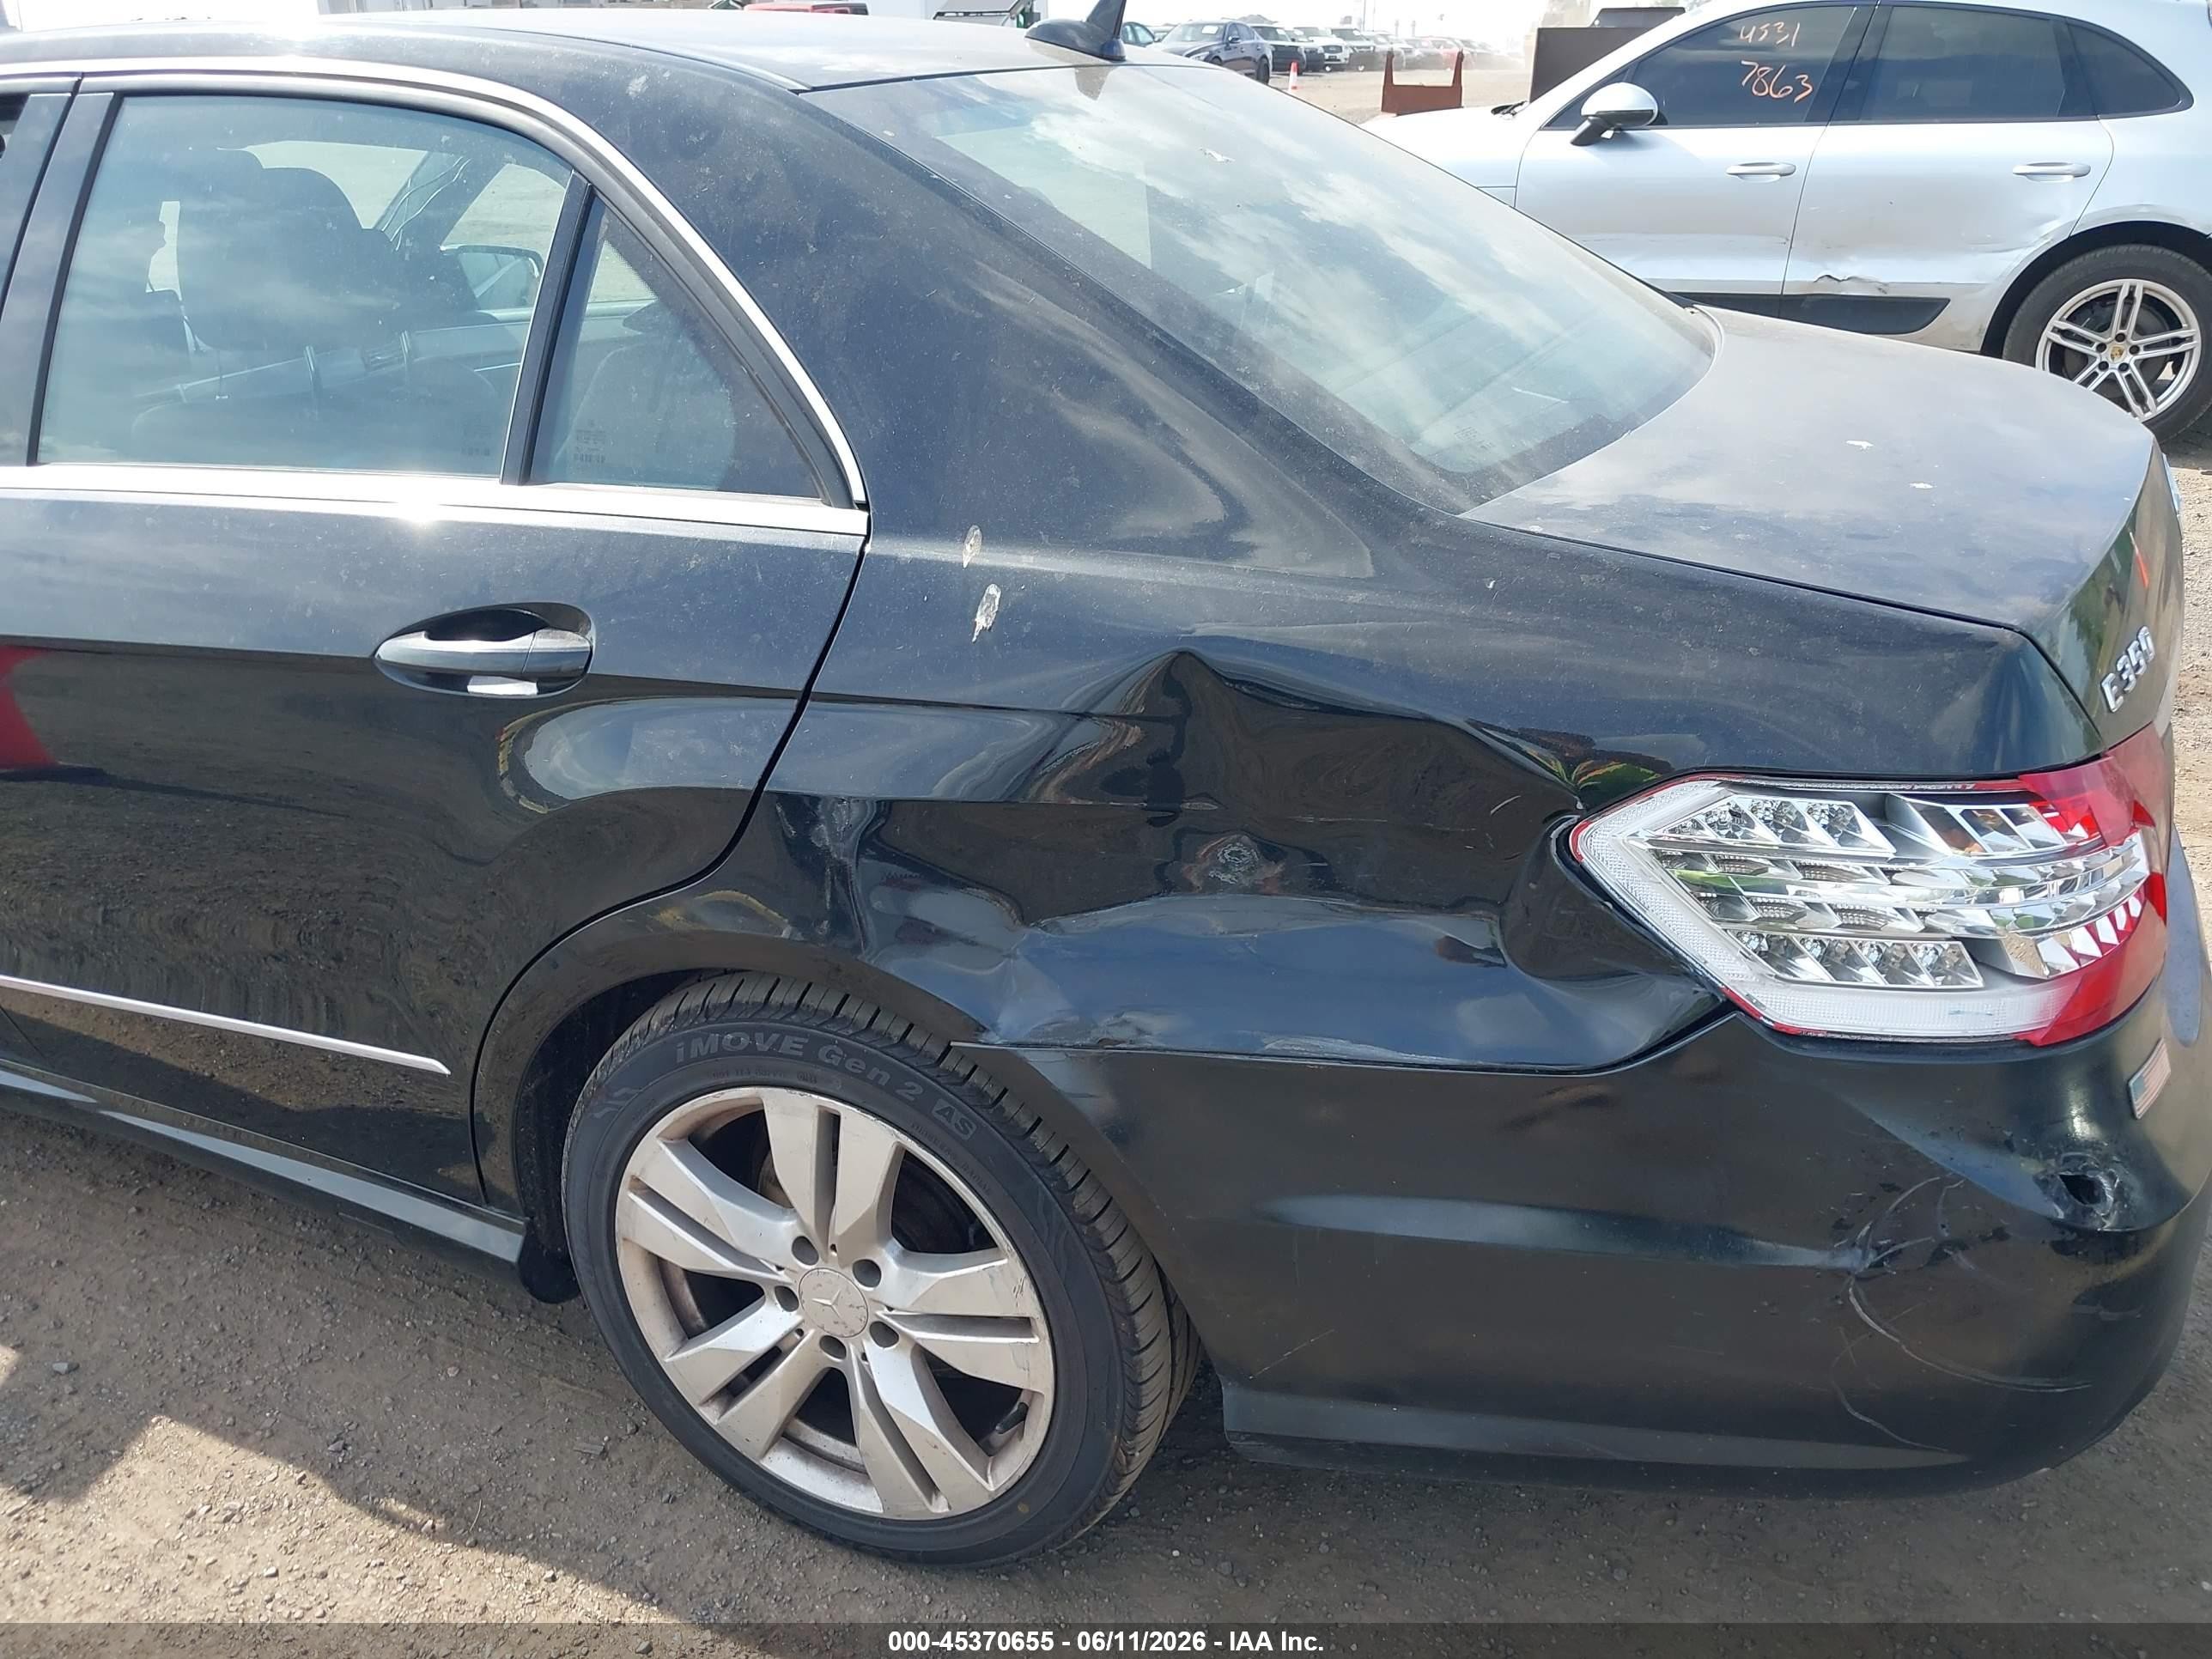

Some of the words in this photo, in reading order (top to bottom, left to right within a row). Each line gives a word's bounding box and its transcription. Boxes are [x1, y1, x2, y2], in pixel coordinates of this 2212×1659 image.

[1741, 60, 1814, 103] 7863
[2101, 626, 2155, 713] E350
[676, 1033, 808, 1063] iMOVE
[817, 1043, 890, 1085] Gen
[896, 1081, 924, 1102] 2
[934, 1104, 975, 1139] AS
